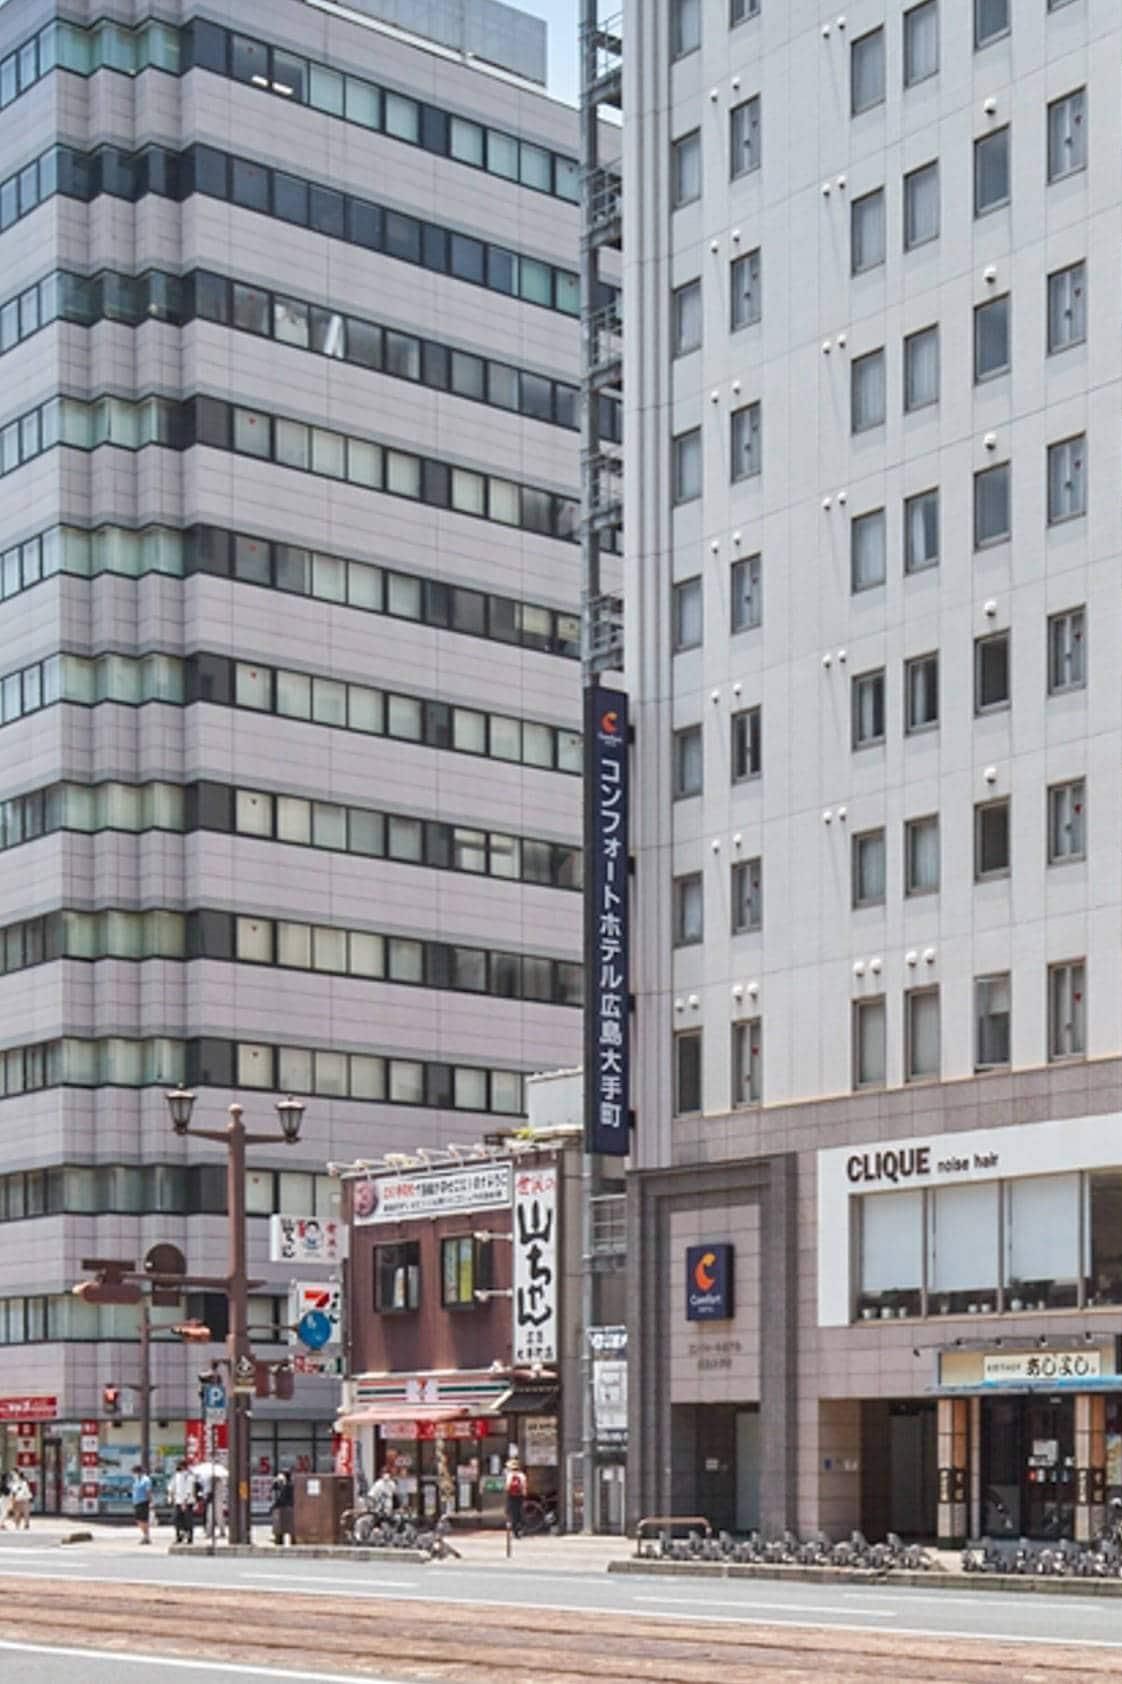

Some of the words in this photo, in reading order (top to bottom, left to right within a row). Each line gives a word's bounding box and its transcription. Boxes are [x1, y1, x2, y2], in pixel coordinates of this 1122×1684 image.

[600, 759, 622, 1128] コンフォートホテル広島大手町
[847, 1147, 931, 1182] CLIQUE
[937, 1157, 970, 1173] noise
[974, 1152, 999, 1168] hair
[517, 1200, 552, 1326] 山ちゃん
[210, 1387, 223, 1405] P
